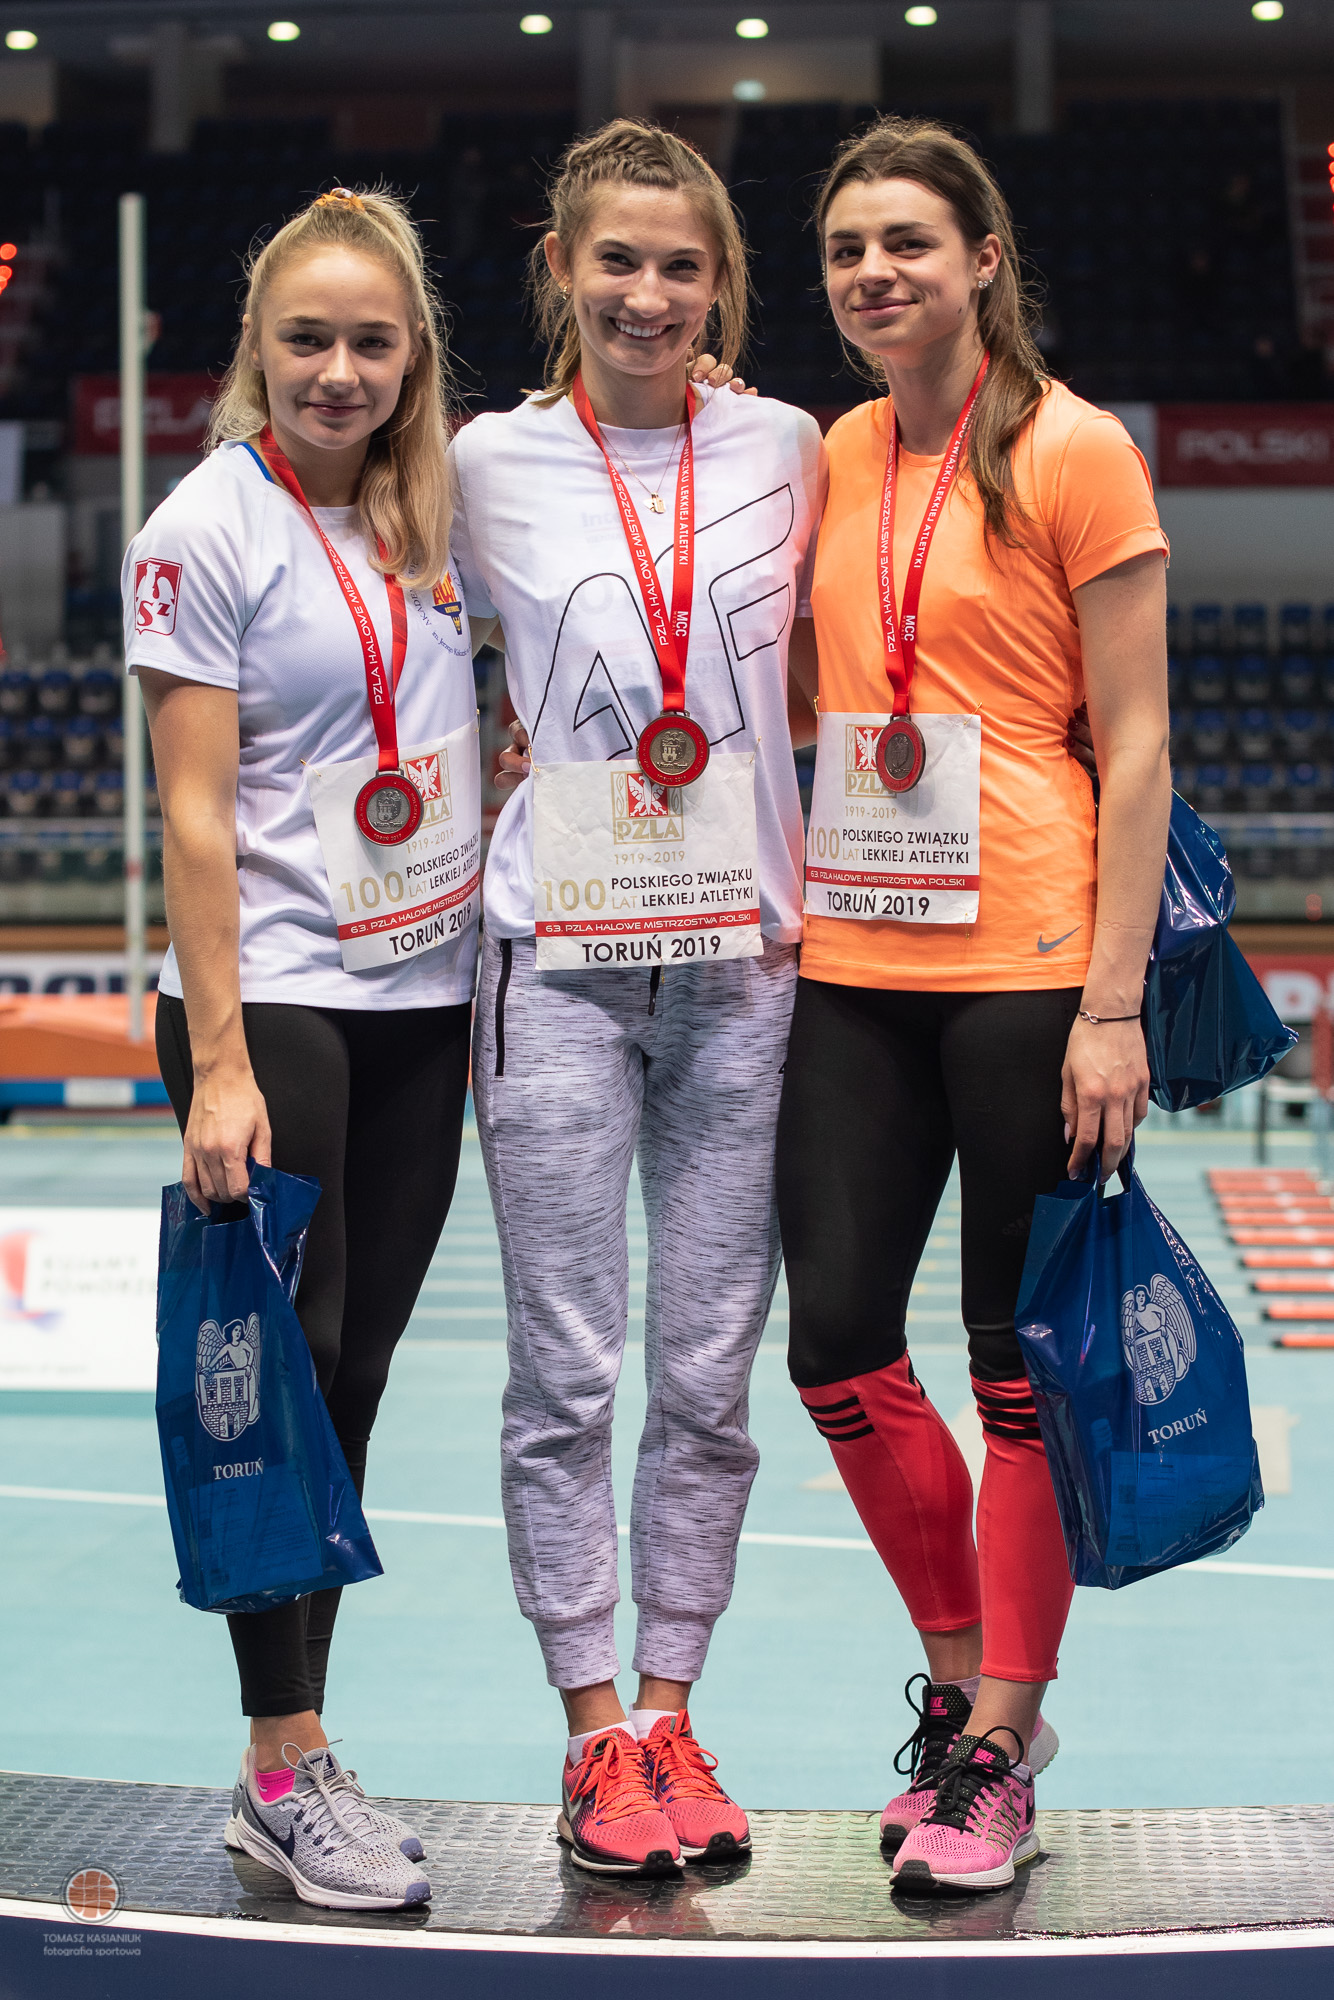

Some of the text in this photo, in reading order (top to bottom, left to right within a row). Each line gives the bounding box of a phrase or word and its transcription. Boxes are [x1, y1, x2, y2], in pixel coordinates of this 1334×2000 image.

[680, 484, 689, 521] LEKKIEJ
[880, 464, 892, 553] MISTRZOSTWA
[927, 486, 946, 521] LEKKIEJ
[608, 458, 669, 646] PZLA HALOWE MISTRZOSTW
[679, 524, 689, 566] ATLETYKI
[914, 524, 932, 568] ATLETYKI
[880, 556, 892, 614] HALOWE
[354, 605, 378, 665] HALOWE
[675, 611, 688, 637] MCC
[885, 616, 896, 653] PZLA
[904, 615, 916, 641] MCC
[372, 666, 385, 705] PZLA
[421, 801, 451, 826] ZLA
[845, 806, 897, 819] 1919-2019
[406, 828, 454, 854] 1919-2019
[616, 818, 682, 841] PZLA
[810, 826, 839, 860] 100
[842, 829, 969, 848] POLSKIEGO ZWIĄZKU
[406, 848, 459, 878] POLSKIEGO
[614, 851, 686, 866] 1919-2019
[842, 848, 969, 864] LAT LEKKIEJ ATLETYKI
[340, 871, 404, 912] 100
[409, 881, 427, 898] LAT
[430, 866, 460, 889] LEKKIEJ
[611, 868, 753, 890] POLSKIEGO ZWIĄZKU
[810, 870, 965, 886] 63. PZLA HALOWE MISTRZOSTWA POLSKI
[542, 879, 606, 912] 100
[612, 887, 753, 910] LAT LEKKIEJ ATLETYKI
[827, 888, 930, 916] TORUŃ 2019
[350, 924, 369, 934] 63.
[371, 917, 398, 930] PZLA
[398, 906, 431, 923] HALOWE
[389, 902, 471, 955] TORUŃ 2019
[545, 913, 751, 933] 63. PZLA HALOWE MISTRZOSTWA POLSKI
[582, 935, 721, 963] TORUŃ 2019
[1148, 1408, 1208, 1444] TORUŃ
[213, 1457, 264, 1480] TORUŃ
[975, 1748, 996, 1764] NIKE
